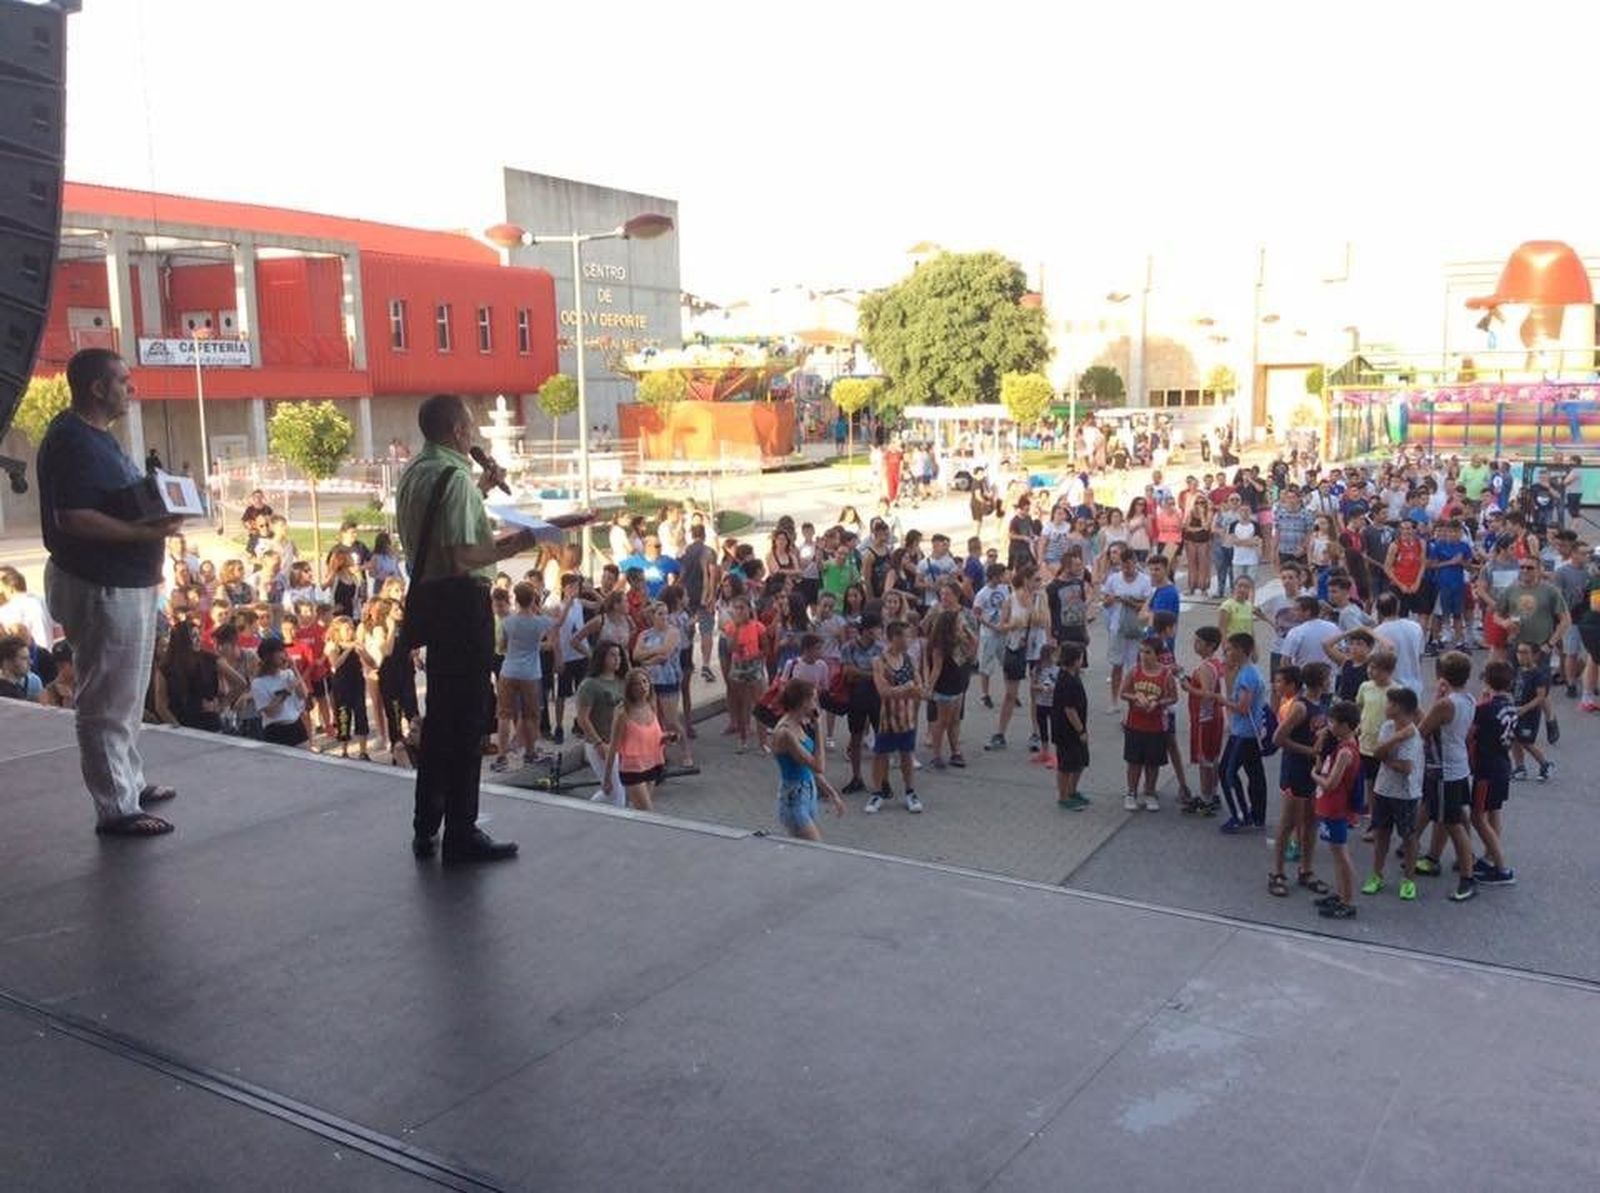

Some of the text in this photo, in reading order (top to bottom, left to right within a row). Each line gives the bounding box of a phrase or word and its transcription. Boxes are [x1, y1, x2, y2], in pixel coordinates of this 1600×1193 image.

[582, 263, 626, 281] CENTRO
[597, 288, 613, 303] DE
[560, 309, 648, 330] OCO Y DEPORTE
